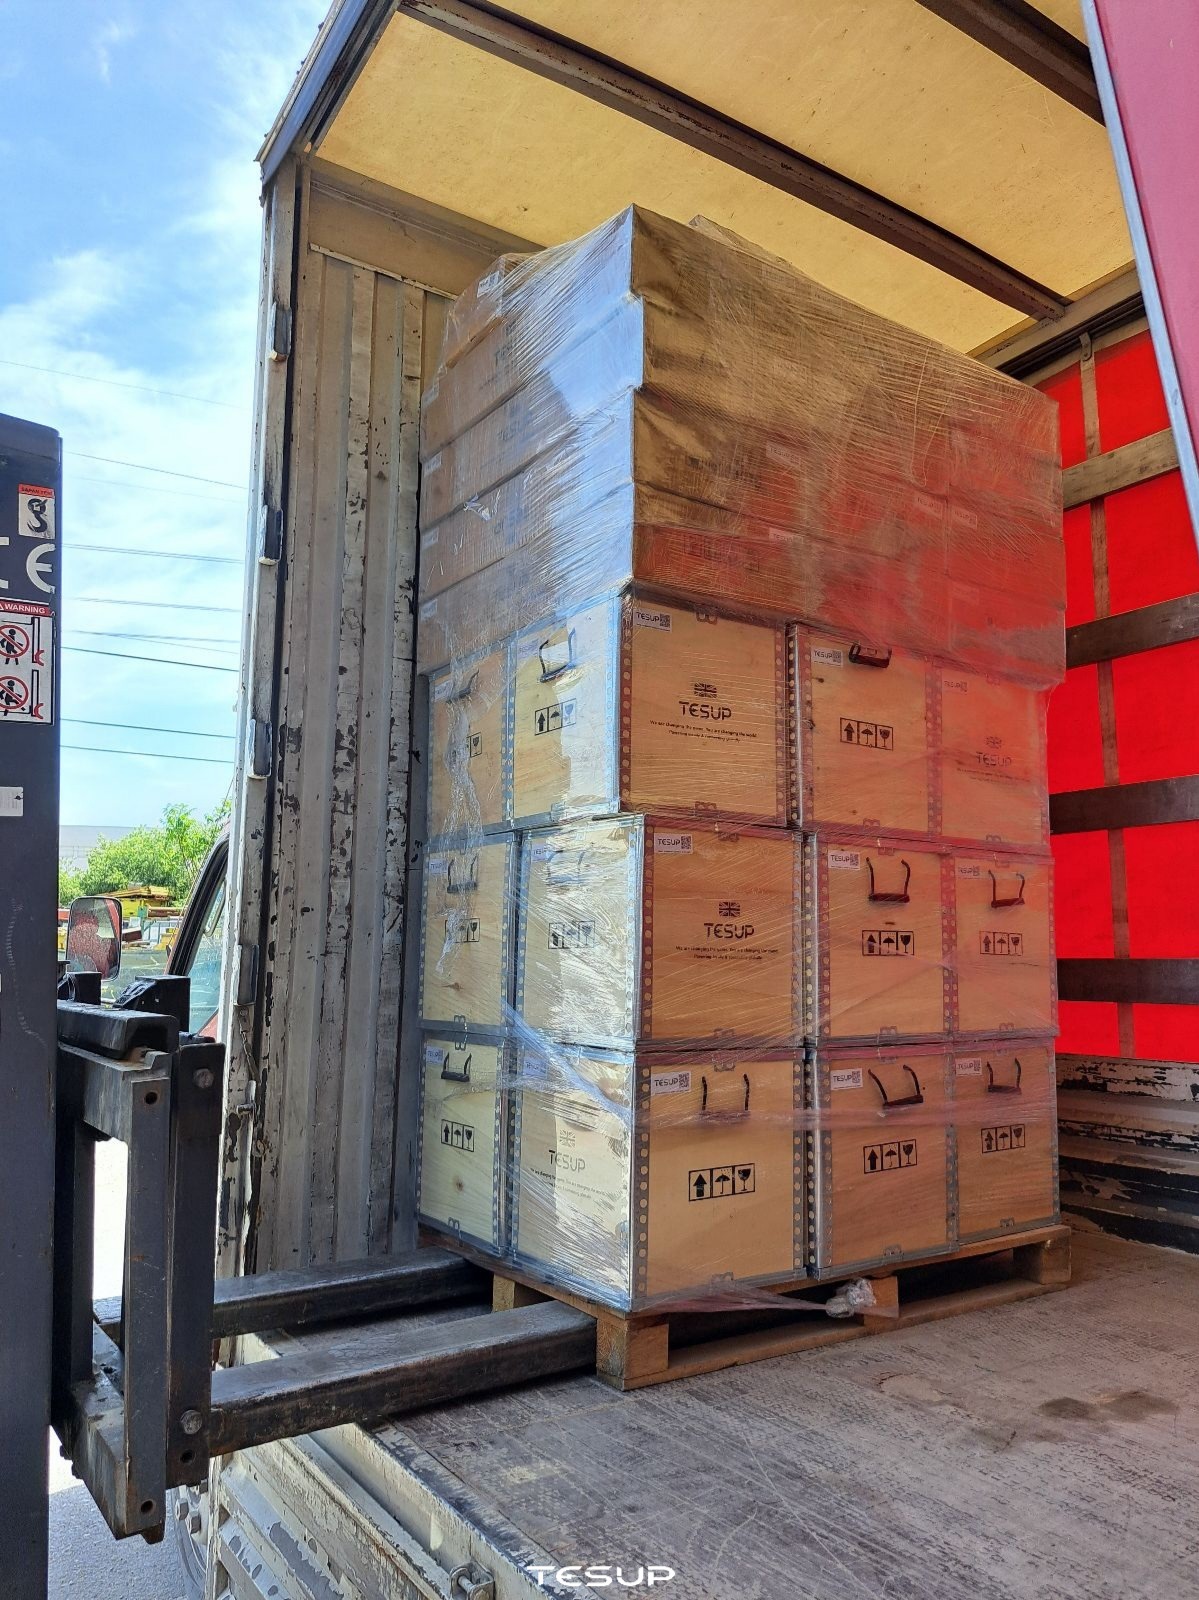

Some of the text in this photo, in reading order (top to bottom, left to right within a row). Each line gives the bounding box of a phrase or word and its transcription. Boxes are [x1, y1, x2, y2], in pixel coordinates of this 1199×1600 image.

[5, 603, 45, 614] WARNING
[636, 611, 660, 622] TESUP
[814, 650, 833, 659] TESUP
[679, 700, 732, 720] TESUP
[976, 751, 1012, 766] TESUP
[658, 838, 680, 846] TESUP
[830, 854, 850, 862] TESUP
[703, 922, 755, 939] TESUP
[654, 1077, 678, 1087] TESUP
[832, 1074, 852, 1083] TESUP
[548, 1149, 586, 1173] TESUP
